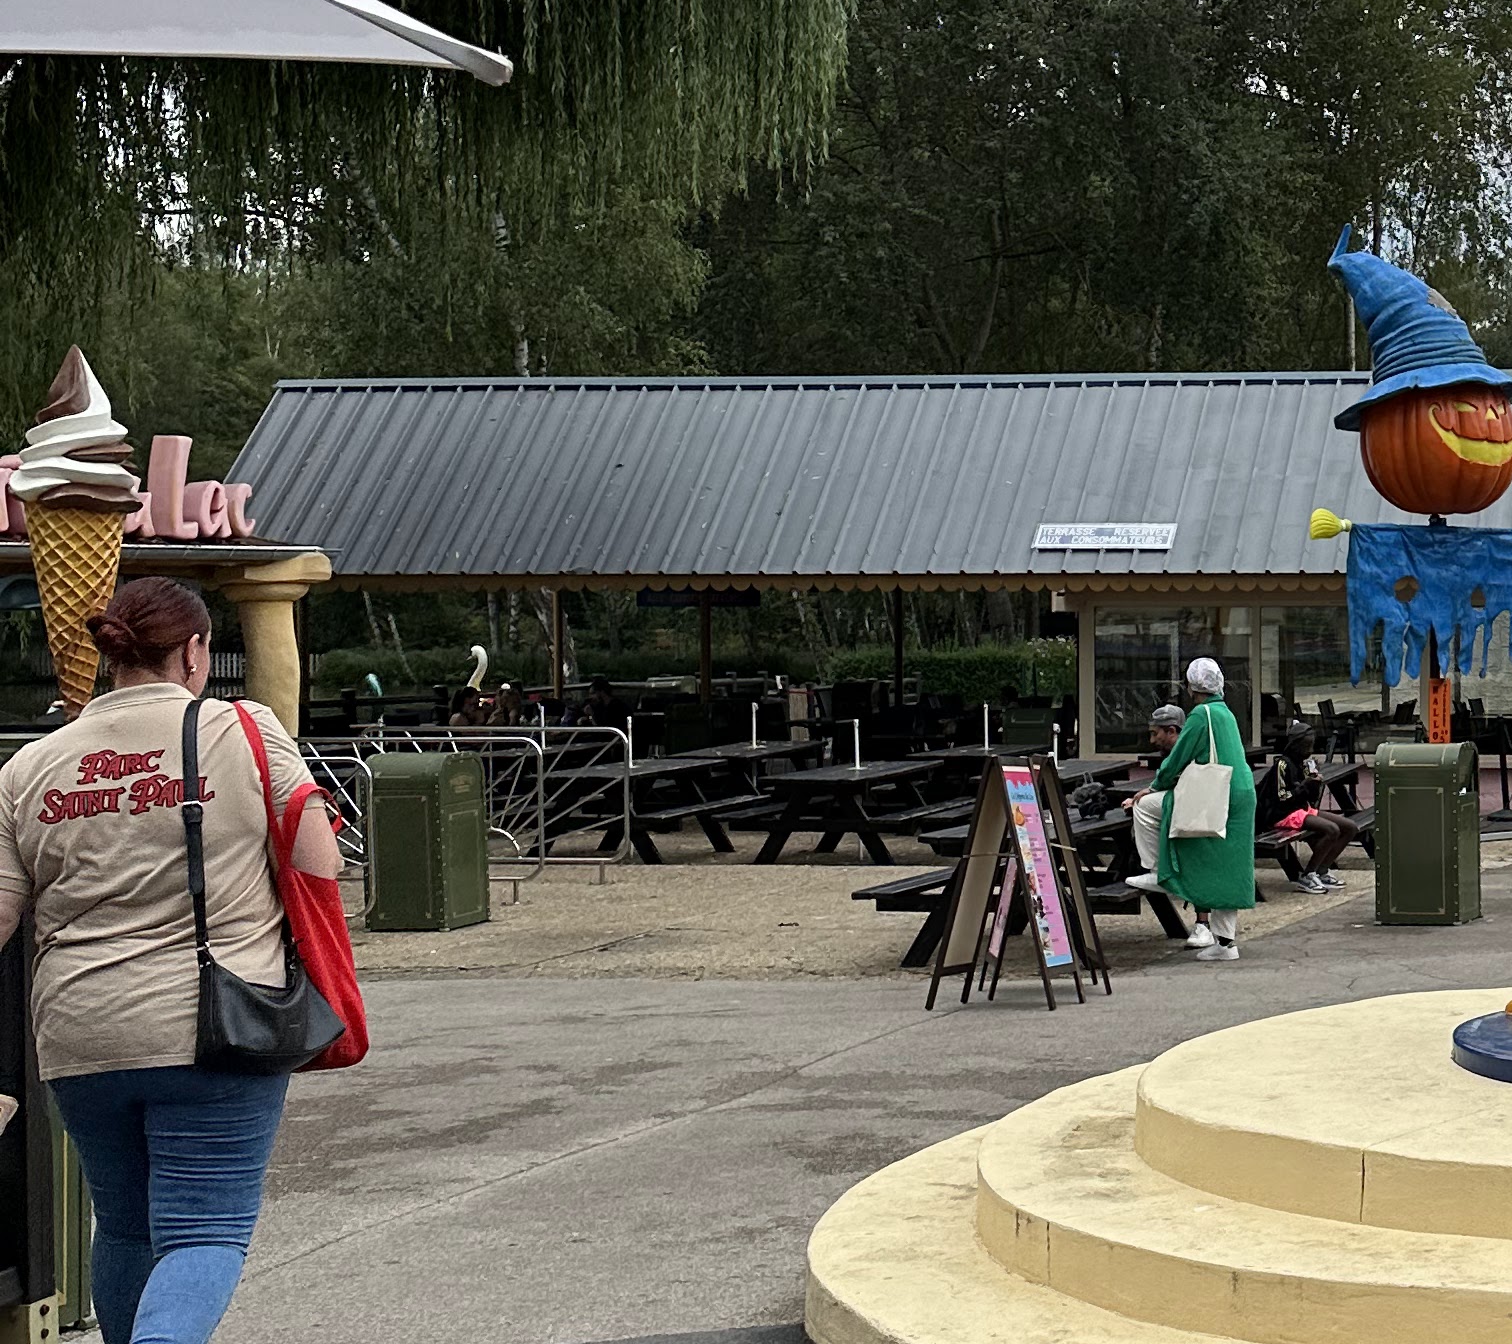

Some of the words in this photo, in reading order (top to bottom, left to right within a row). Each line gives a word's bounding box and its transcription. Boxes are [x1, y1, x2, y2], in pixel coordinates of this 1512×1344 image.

[1039, 536, 1062, 545] AUX
[1070, 536, 1163, 545] CONSOMMATEURS
[1042, 527, 1097, 536] TERRASSE
[77, 749, 166, 785] PARC
[37, 786, 126, 824] SAINT
